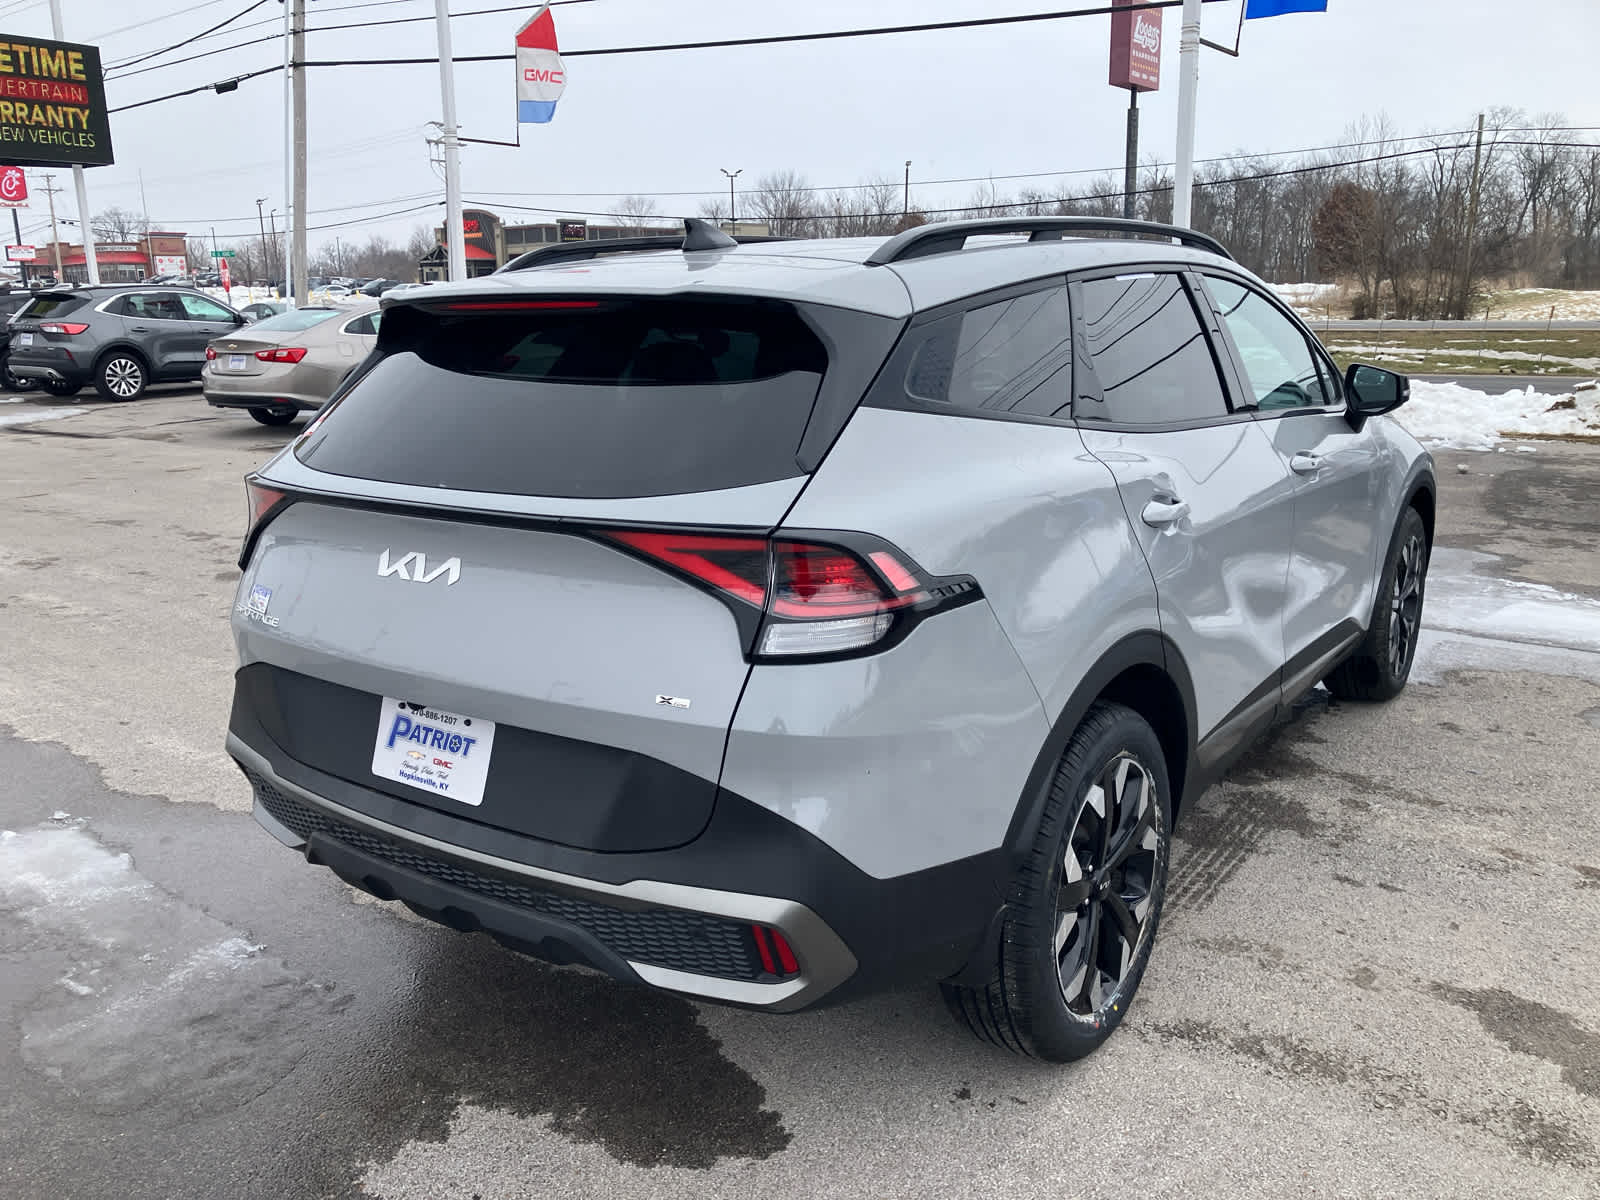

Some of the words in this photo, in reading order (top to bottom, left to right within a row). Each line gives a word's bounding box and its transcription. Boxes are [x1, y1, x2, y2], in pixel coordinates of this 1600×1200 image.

[524, 68, 563, 84] GMC
[0, 126, 25, 142] EW
[28, 129, 96, 148] VEHICLES
[378, 548, 462, 586] KIA
[433, 758, 453, 769] GMC
[439, 782, 449, 791] KY
